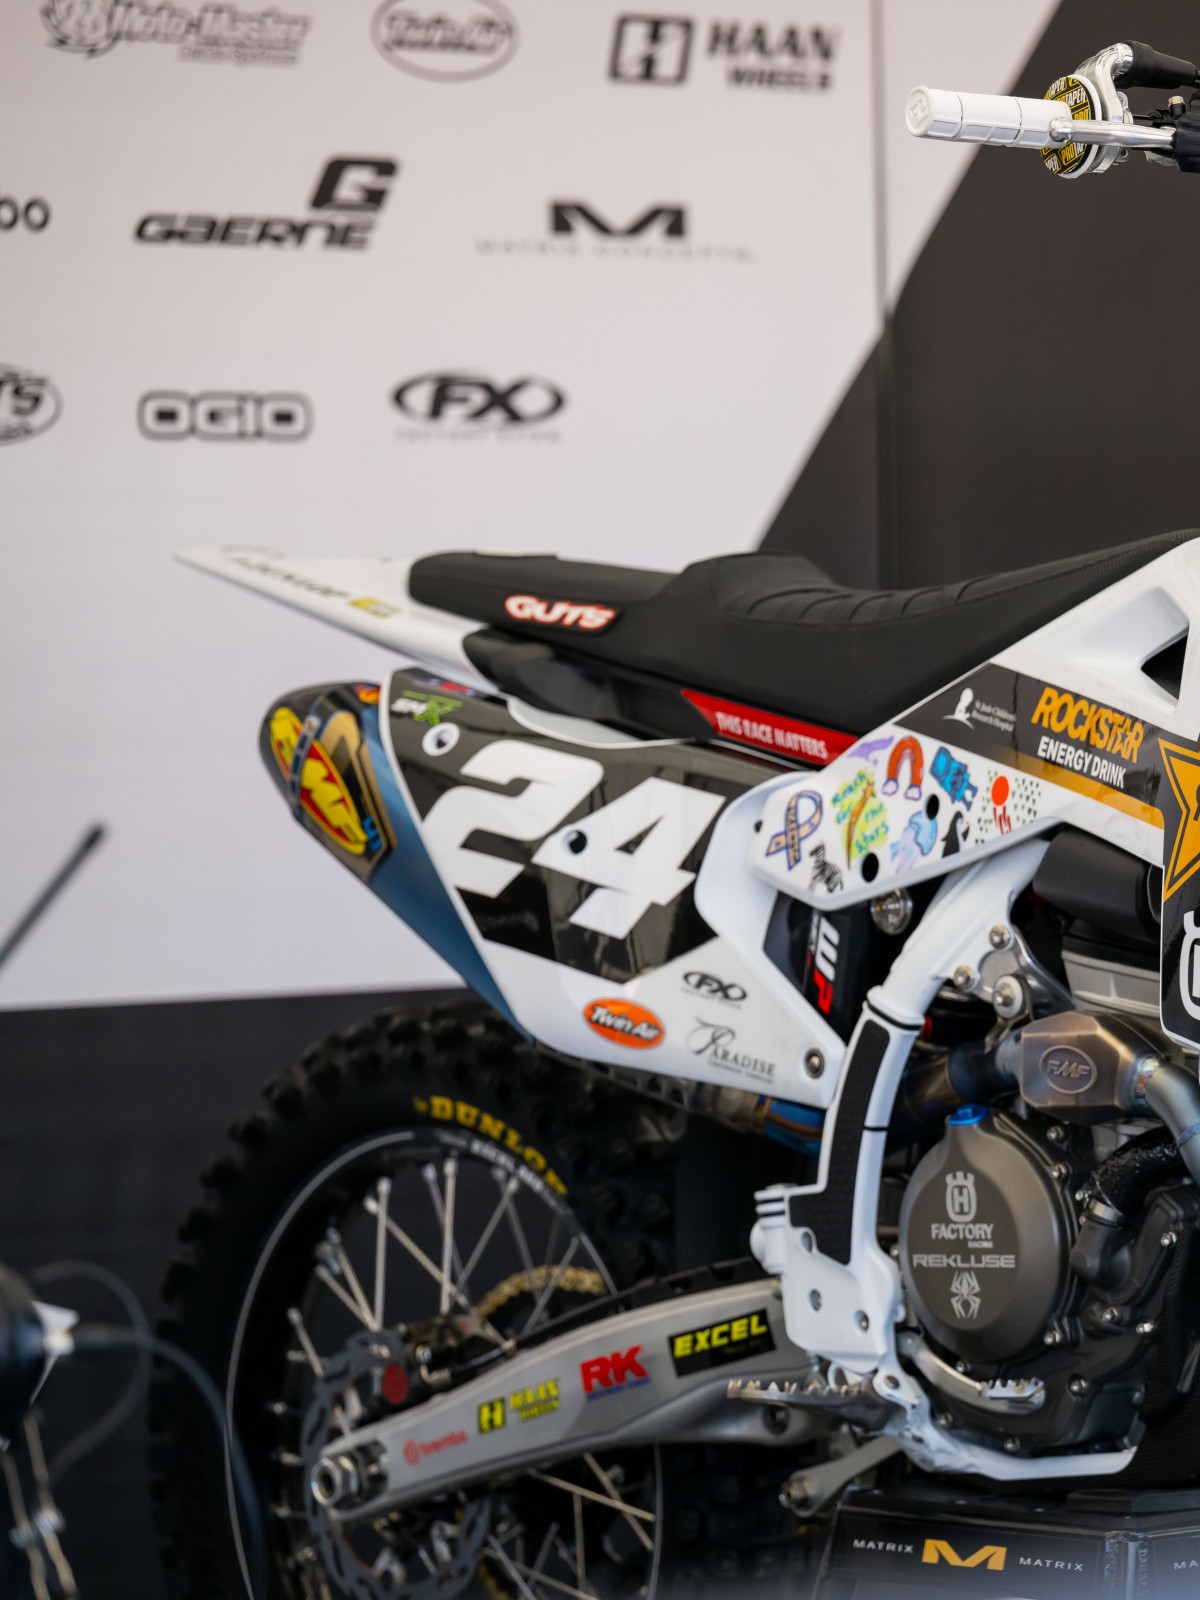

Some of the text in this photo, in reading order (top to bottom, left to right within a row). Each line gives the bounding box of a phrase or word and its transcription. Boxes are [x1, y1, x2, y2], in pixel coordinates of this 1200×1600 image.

[138, 391, 313, 441] OGIO
[505, 595, 617, 631] GUTS
[716, 711, 828, 759] THIS RACE MATTERS
[1030, 686, 1145, 764] ROCKSTAR
[1036, 735, 1127, 789] ENERGY DRINK
[422, 739, 727, 940] 24
[429, 1094, 569, 1196] DUNLOP
[930, 1222, 995, 1240] FACTORY
[912, 1253, 1016, 1269] REKLUSE
[673, 1313, 768, 1359] EXCEL
[580, 1344, 648, 1394] RK
[853, 1538, 915, 1554] MATRIX
[1018, 1556, 1085, 1572] MATRIX
